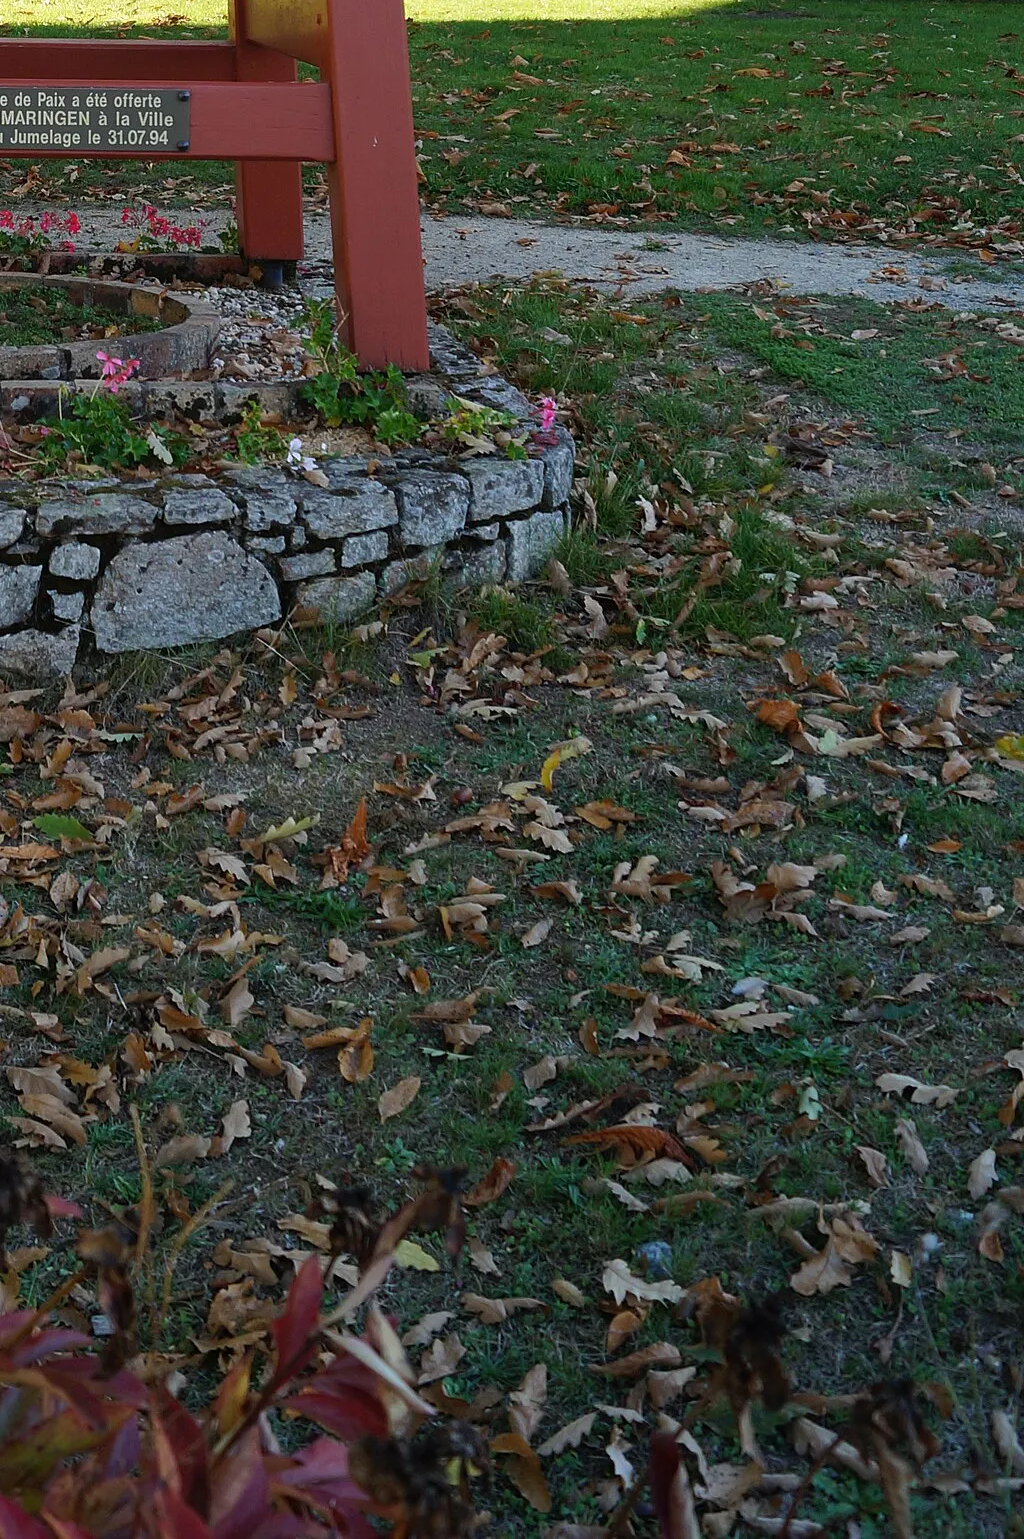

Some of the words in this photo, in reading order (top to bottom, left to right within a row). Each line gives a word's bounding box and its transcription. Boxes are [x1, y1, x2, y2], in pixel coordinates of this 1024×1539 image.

[14, 92, 31, 107] de
[38, 92, 65, 107] Paix
[72, 96, 79, 107] a
[86, 93, 107, 107] été
[114, 93, 162, 108] offerte
[98, 111, 107, 125] à
[116, 112, 129, 126] la
[138, 112, 173, 127] Ville
[10, 130, 80, 147] Jumelage
[88, 130, 100, 144] le
[108, 130, 168, 145] 31.07.94
